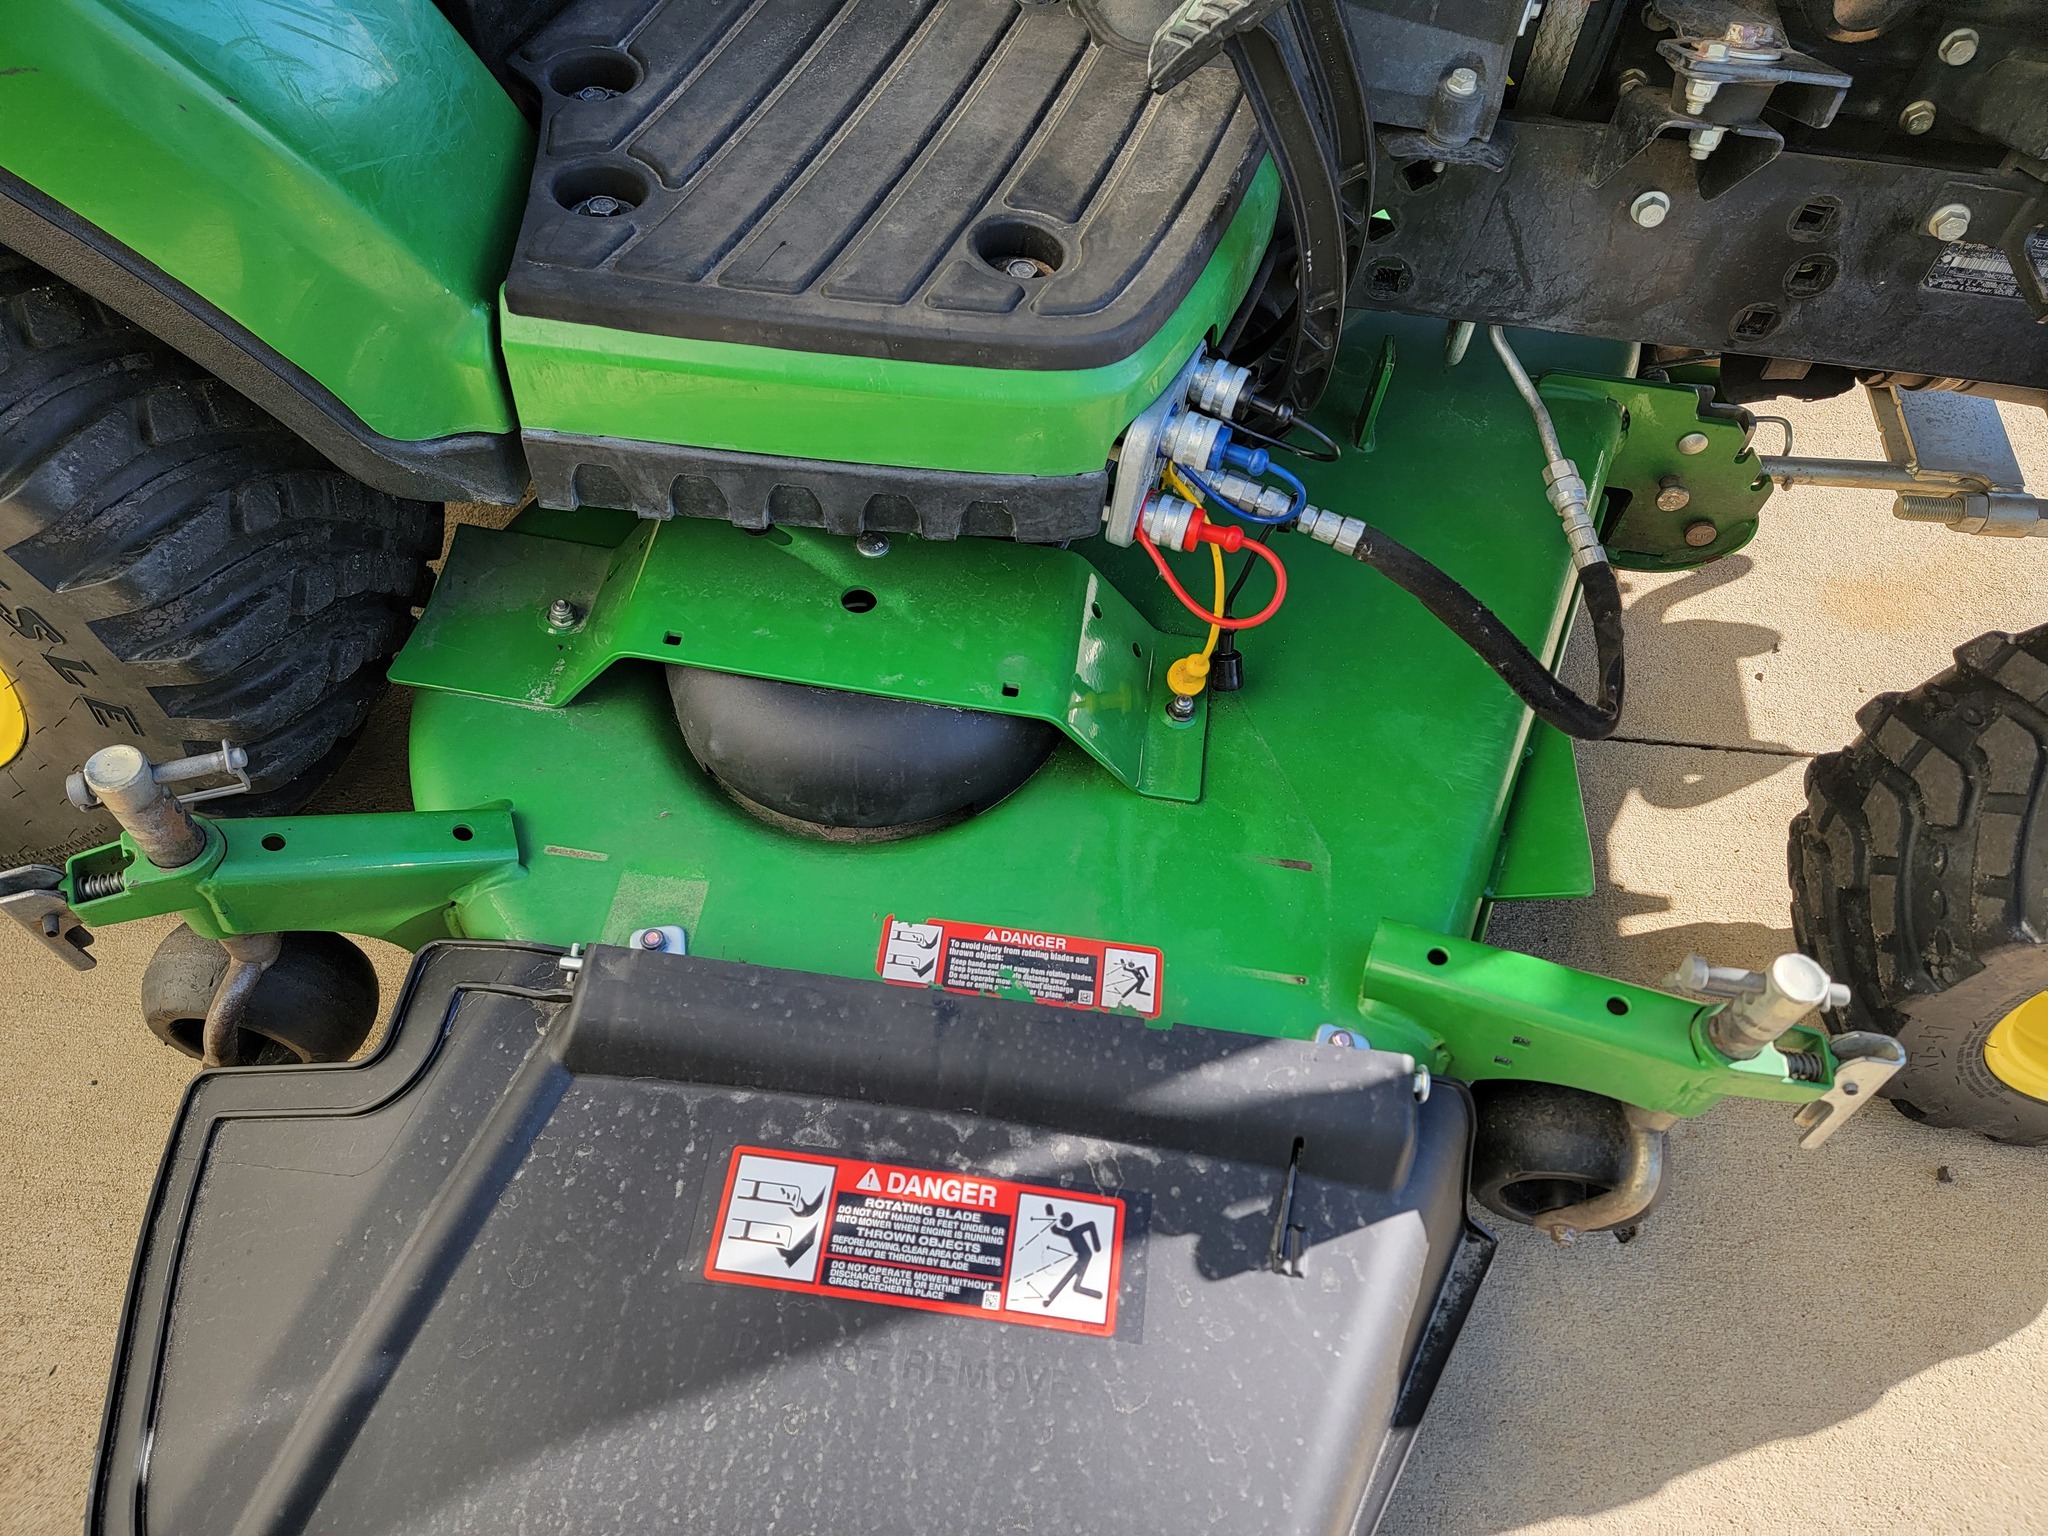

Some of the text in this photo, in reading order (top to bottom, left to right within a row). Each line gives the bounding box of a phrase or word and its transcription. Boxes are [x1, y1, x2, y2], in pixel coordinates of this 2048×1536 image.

[951, 939, 1089, 964] To avoid injury from rotating blades and
[1001, 931, 1066, 949] DANGER
[949, 948, 1004, 961] thrown objects:
[949, 965, 965, 973] Keep
[951, 957, 966, 966] Keep
[968, 960, 986, 968] hands
[987, 962, 999, 970] and
[1046, 969, 1070, 980] rotating
[1071, 972, 1094, 982] blades.
[948, 979, 965, 987] chute
[971, 975, 995, 984] operate
[1044, 984, 1074, 994] discharge
[887, 1172, 997, 1207] DANGER
[838, 1205, 1005, 1236] DO NOT PUT HANDS OR FEET UNDER OR
[865, 1198, 981, 1222] ROTATING BLADE
[836, 1214, 1003, 1245] INTO MOWER WHEN ENGINE IS RUNNING
[856, 1227, 981, 1253] THROWN OBJECTS
[831, 1244, 969, 1271] THAT MAY BE THROWN BY BLADE
[833, 1235, 1001, 1266] BEFORE MOWING, CLEAR AREA OF OBJECTS
[829, 1277, 944, 1299] GRASS CATCHER IN PLACE
[830, 1269, 960, 1294] DISCHARGE CHUTE OR ENTIRE
[831, 1261, 994, 1291] DO NOT OPERATE MOWER WITHOUT
